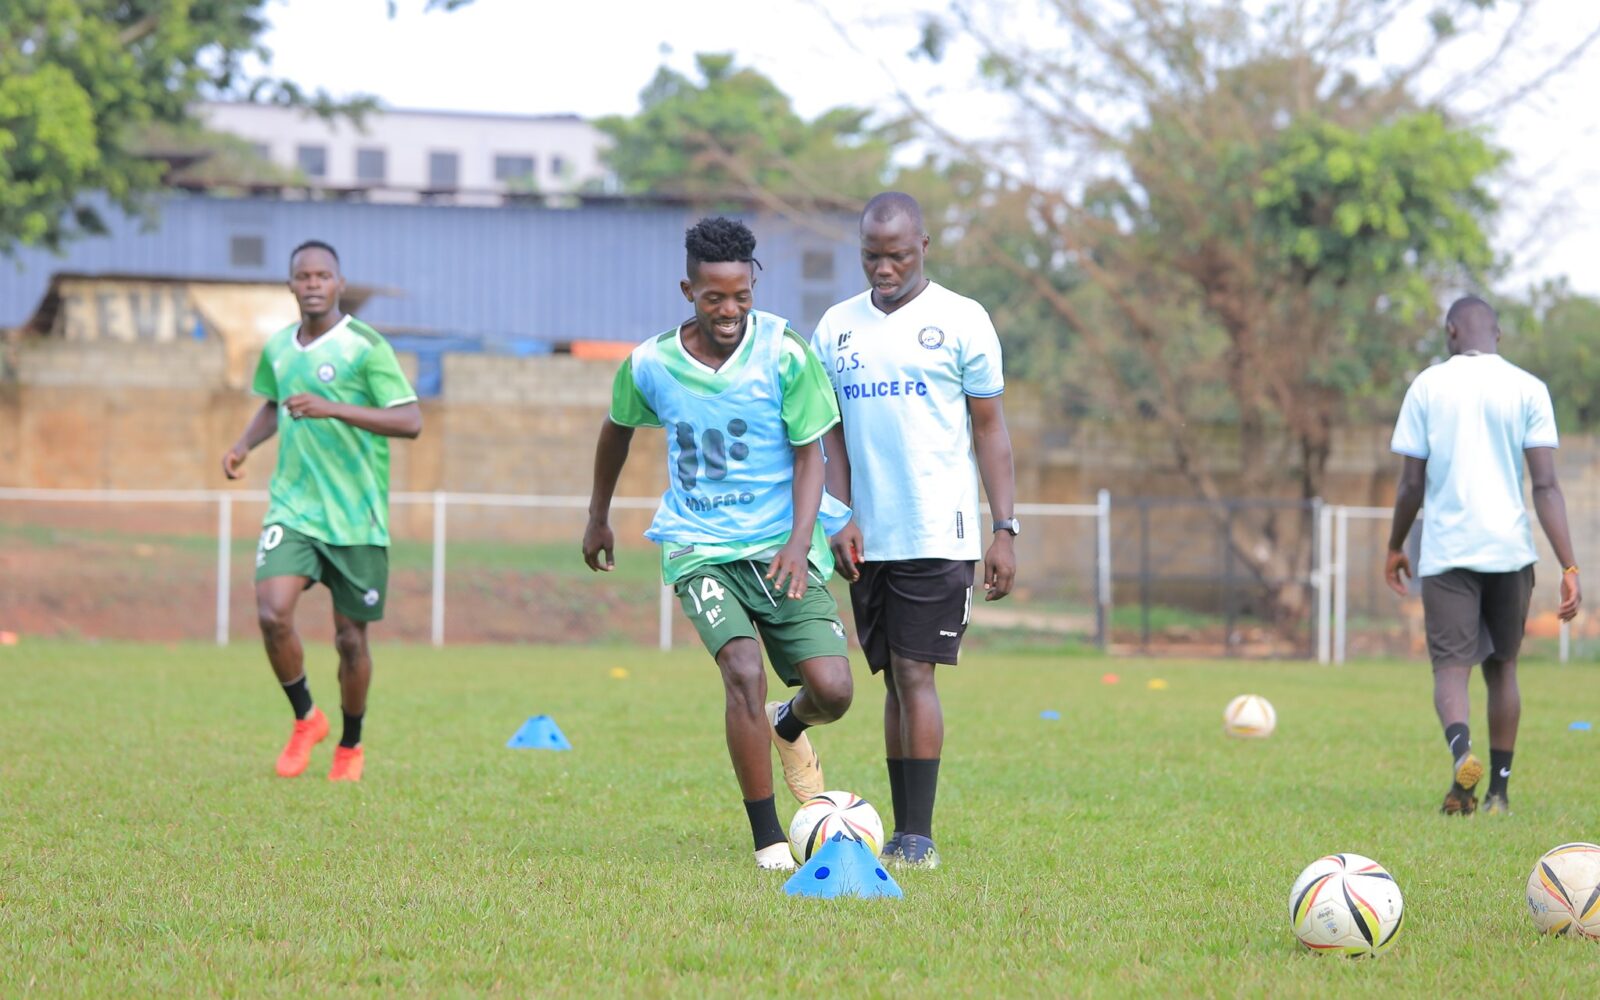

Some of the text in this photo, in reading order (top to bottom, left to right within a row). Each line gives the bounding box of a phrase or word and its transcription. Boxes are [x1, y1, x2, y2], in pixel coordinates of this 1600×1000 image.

[843, 381, 927, 400] POLICE FC
[687, 577, 725, 615] 14
